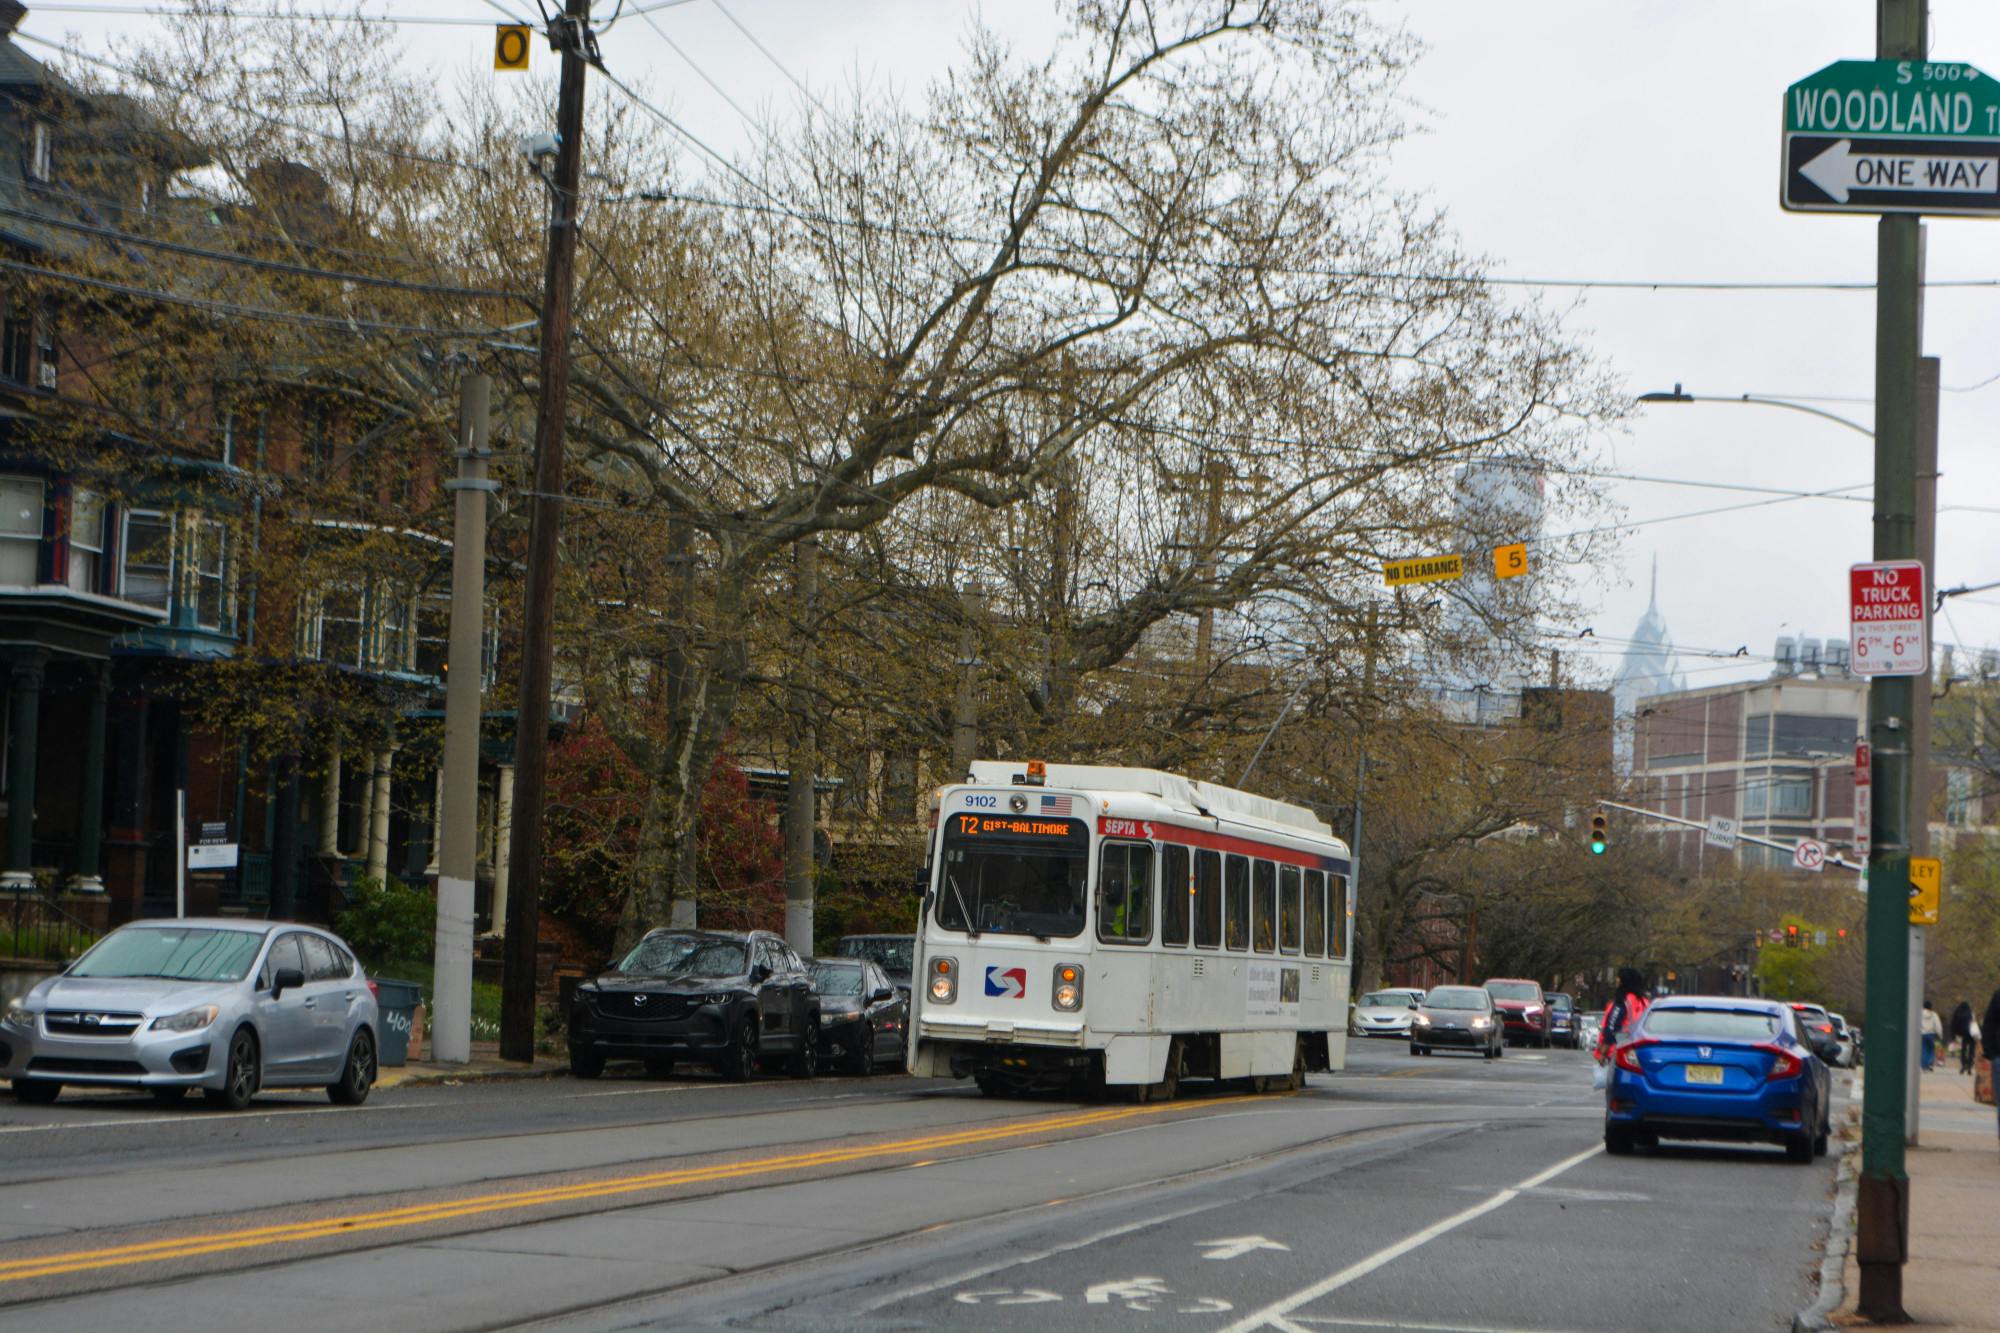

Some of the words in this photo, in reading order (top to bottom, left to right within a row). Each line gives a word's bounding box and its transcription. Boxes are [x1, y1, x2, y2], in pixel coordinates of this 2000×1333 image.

[1896, 61, 1912, 84] S
[1922, 64, 1961, 81] 500
[1795, 87, 1973, 134] WOODLAND
[1985, 104, 2000, 135] T
[1856, 158, 1915, 187] ONE
[1927, 160, 1988, 188] WAY
[1509, 551, 1522, 568] 5
[1386, 567, 1400, 581] NO
[1403, 559, 1459, 578] CLEARANCE
[1873, 570, 1899, 585] NO
[1861, 586, 1911, 603] TRUCK
[1854, 603, 1920, 620] PARKING
[965, 795, 997, 808] 9102
[960, 816, 979, 835] T2
[1105, 819, 1136, 836] SEPTA
[1717, 820, 1730, 832] NO
